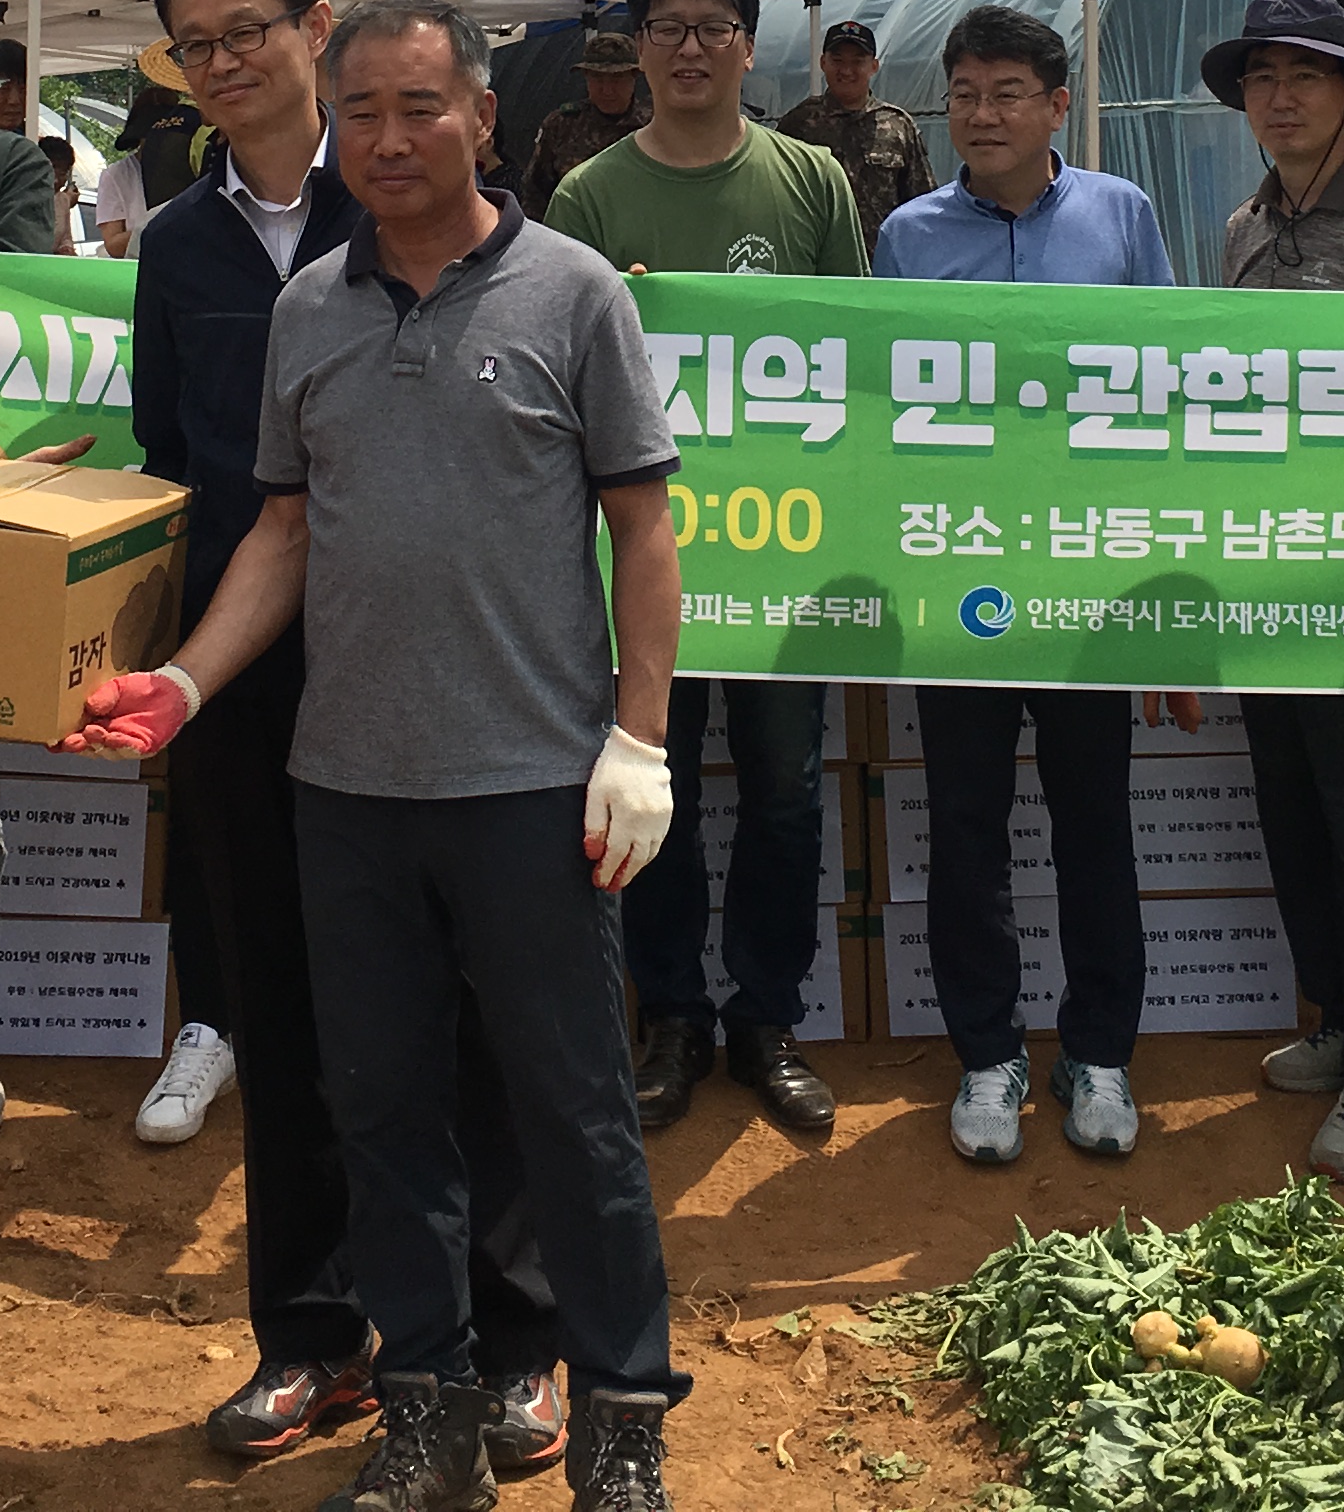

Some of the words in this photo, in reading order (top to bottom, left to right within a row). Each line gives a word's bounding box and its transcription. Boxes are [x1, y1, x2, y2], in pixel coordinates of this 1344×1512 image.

[900, 503, 1004, 557] 장소
[1049, 506, 1208, 560] 남동구
[762, 594, 882, 628] 남촌두레
[1026, 597, 1162, 634] 인천광역시
[67, 631, 107, 690] 감자
